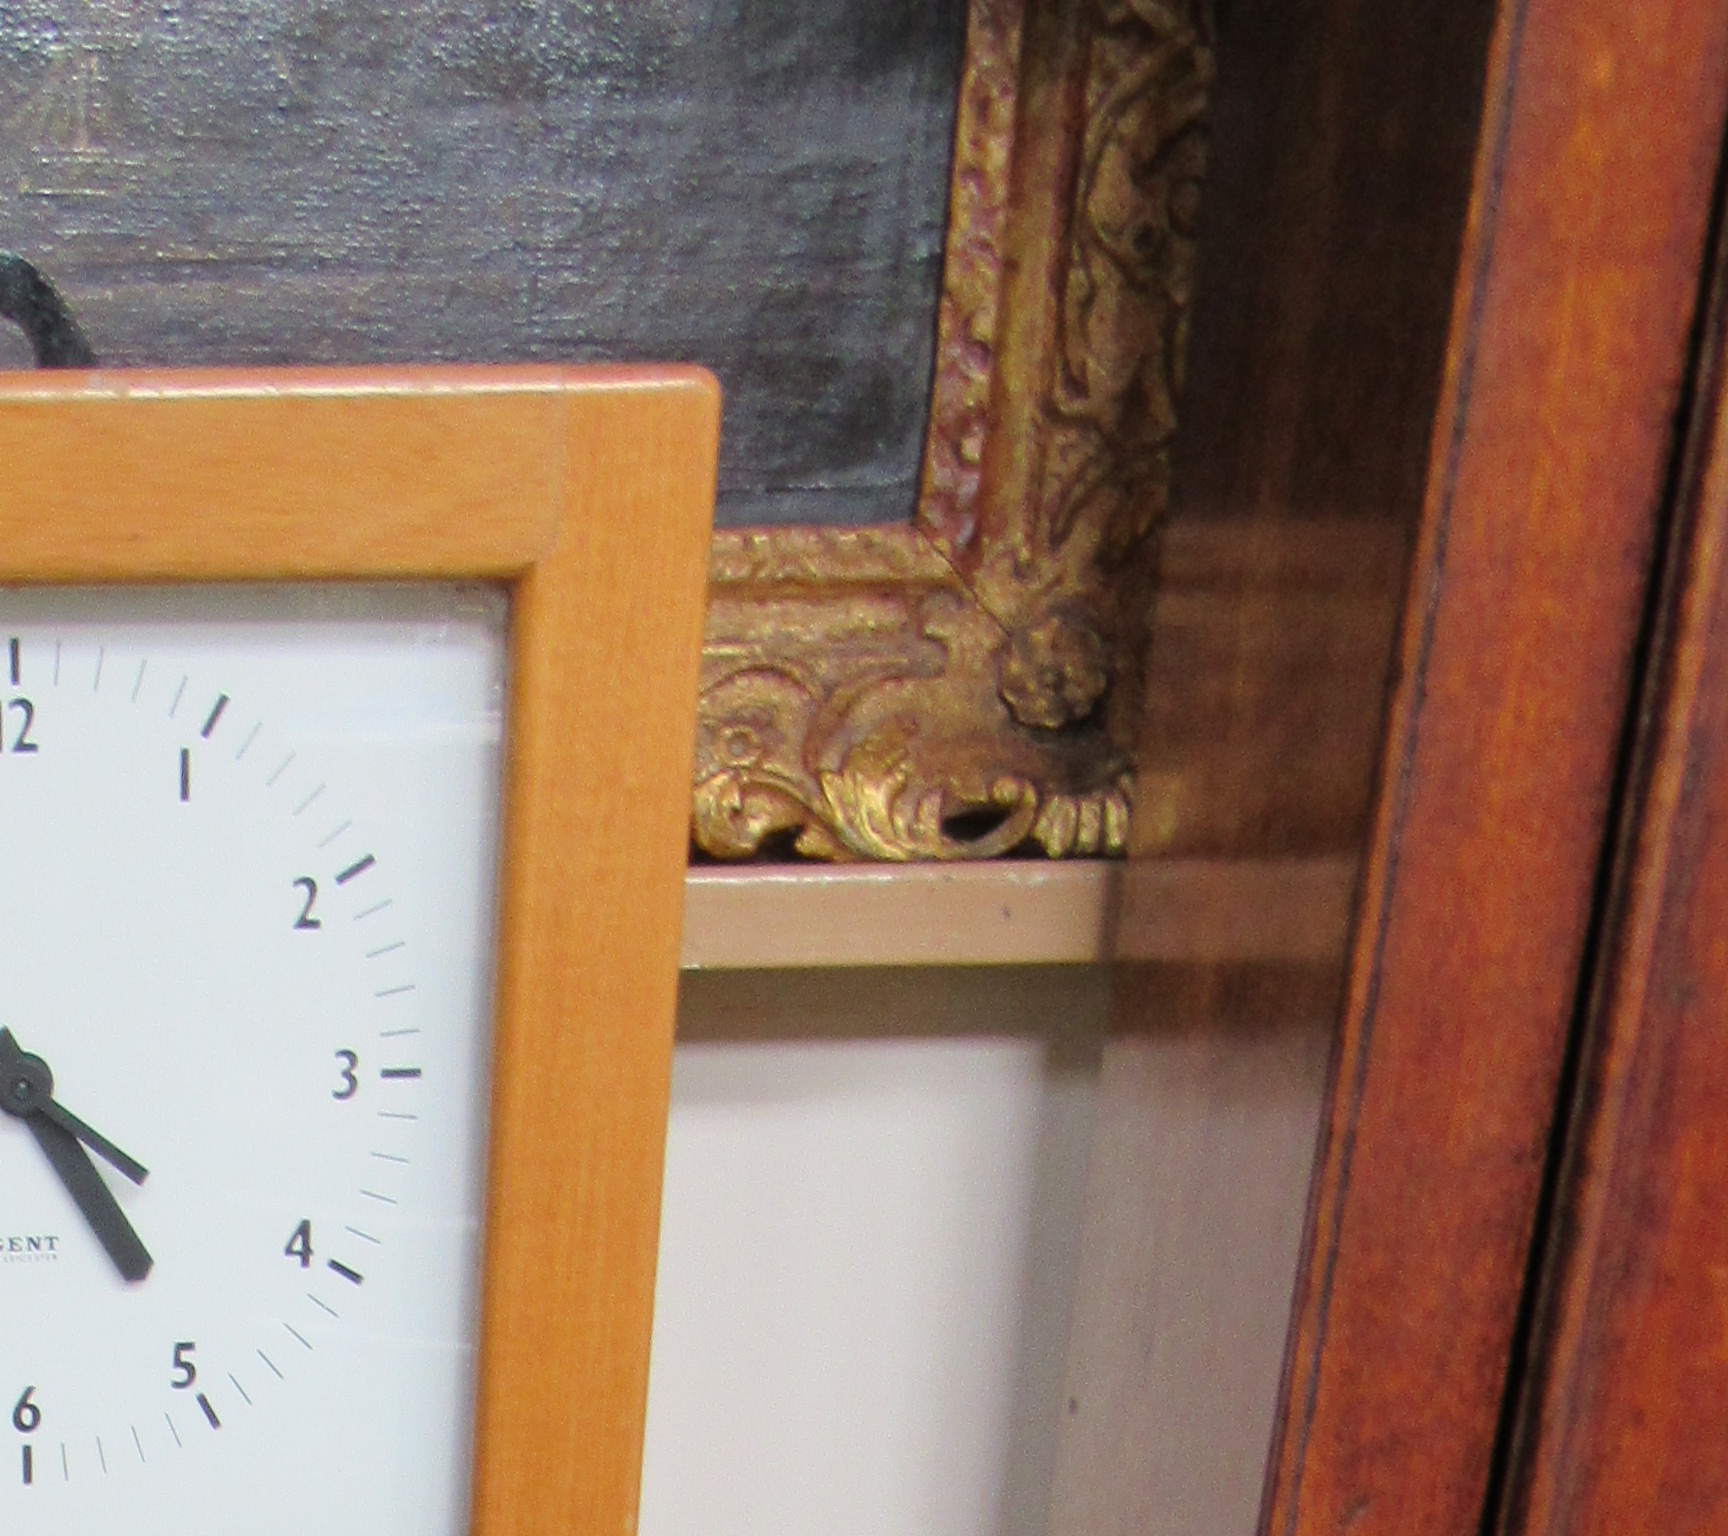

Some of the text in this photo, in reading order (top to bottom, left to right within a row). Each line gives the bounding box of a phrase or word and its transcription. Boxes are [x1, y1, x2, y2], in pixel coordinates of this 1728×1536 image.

[179, 748, 190, 802] 1
[293, 876, 321, 930] 2
[332, 1048, 359, 1100] 3
[284, 1219, 314, 1268] 4
[171, 1341, 197, 1389] 5
[12, 1385, 42, 1433] 6
